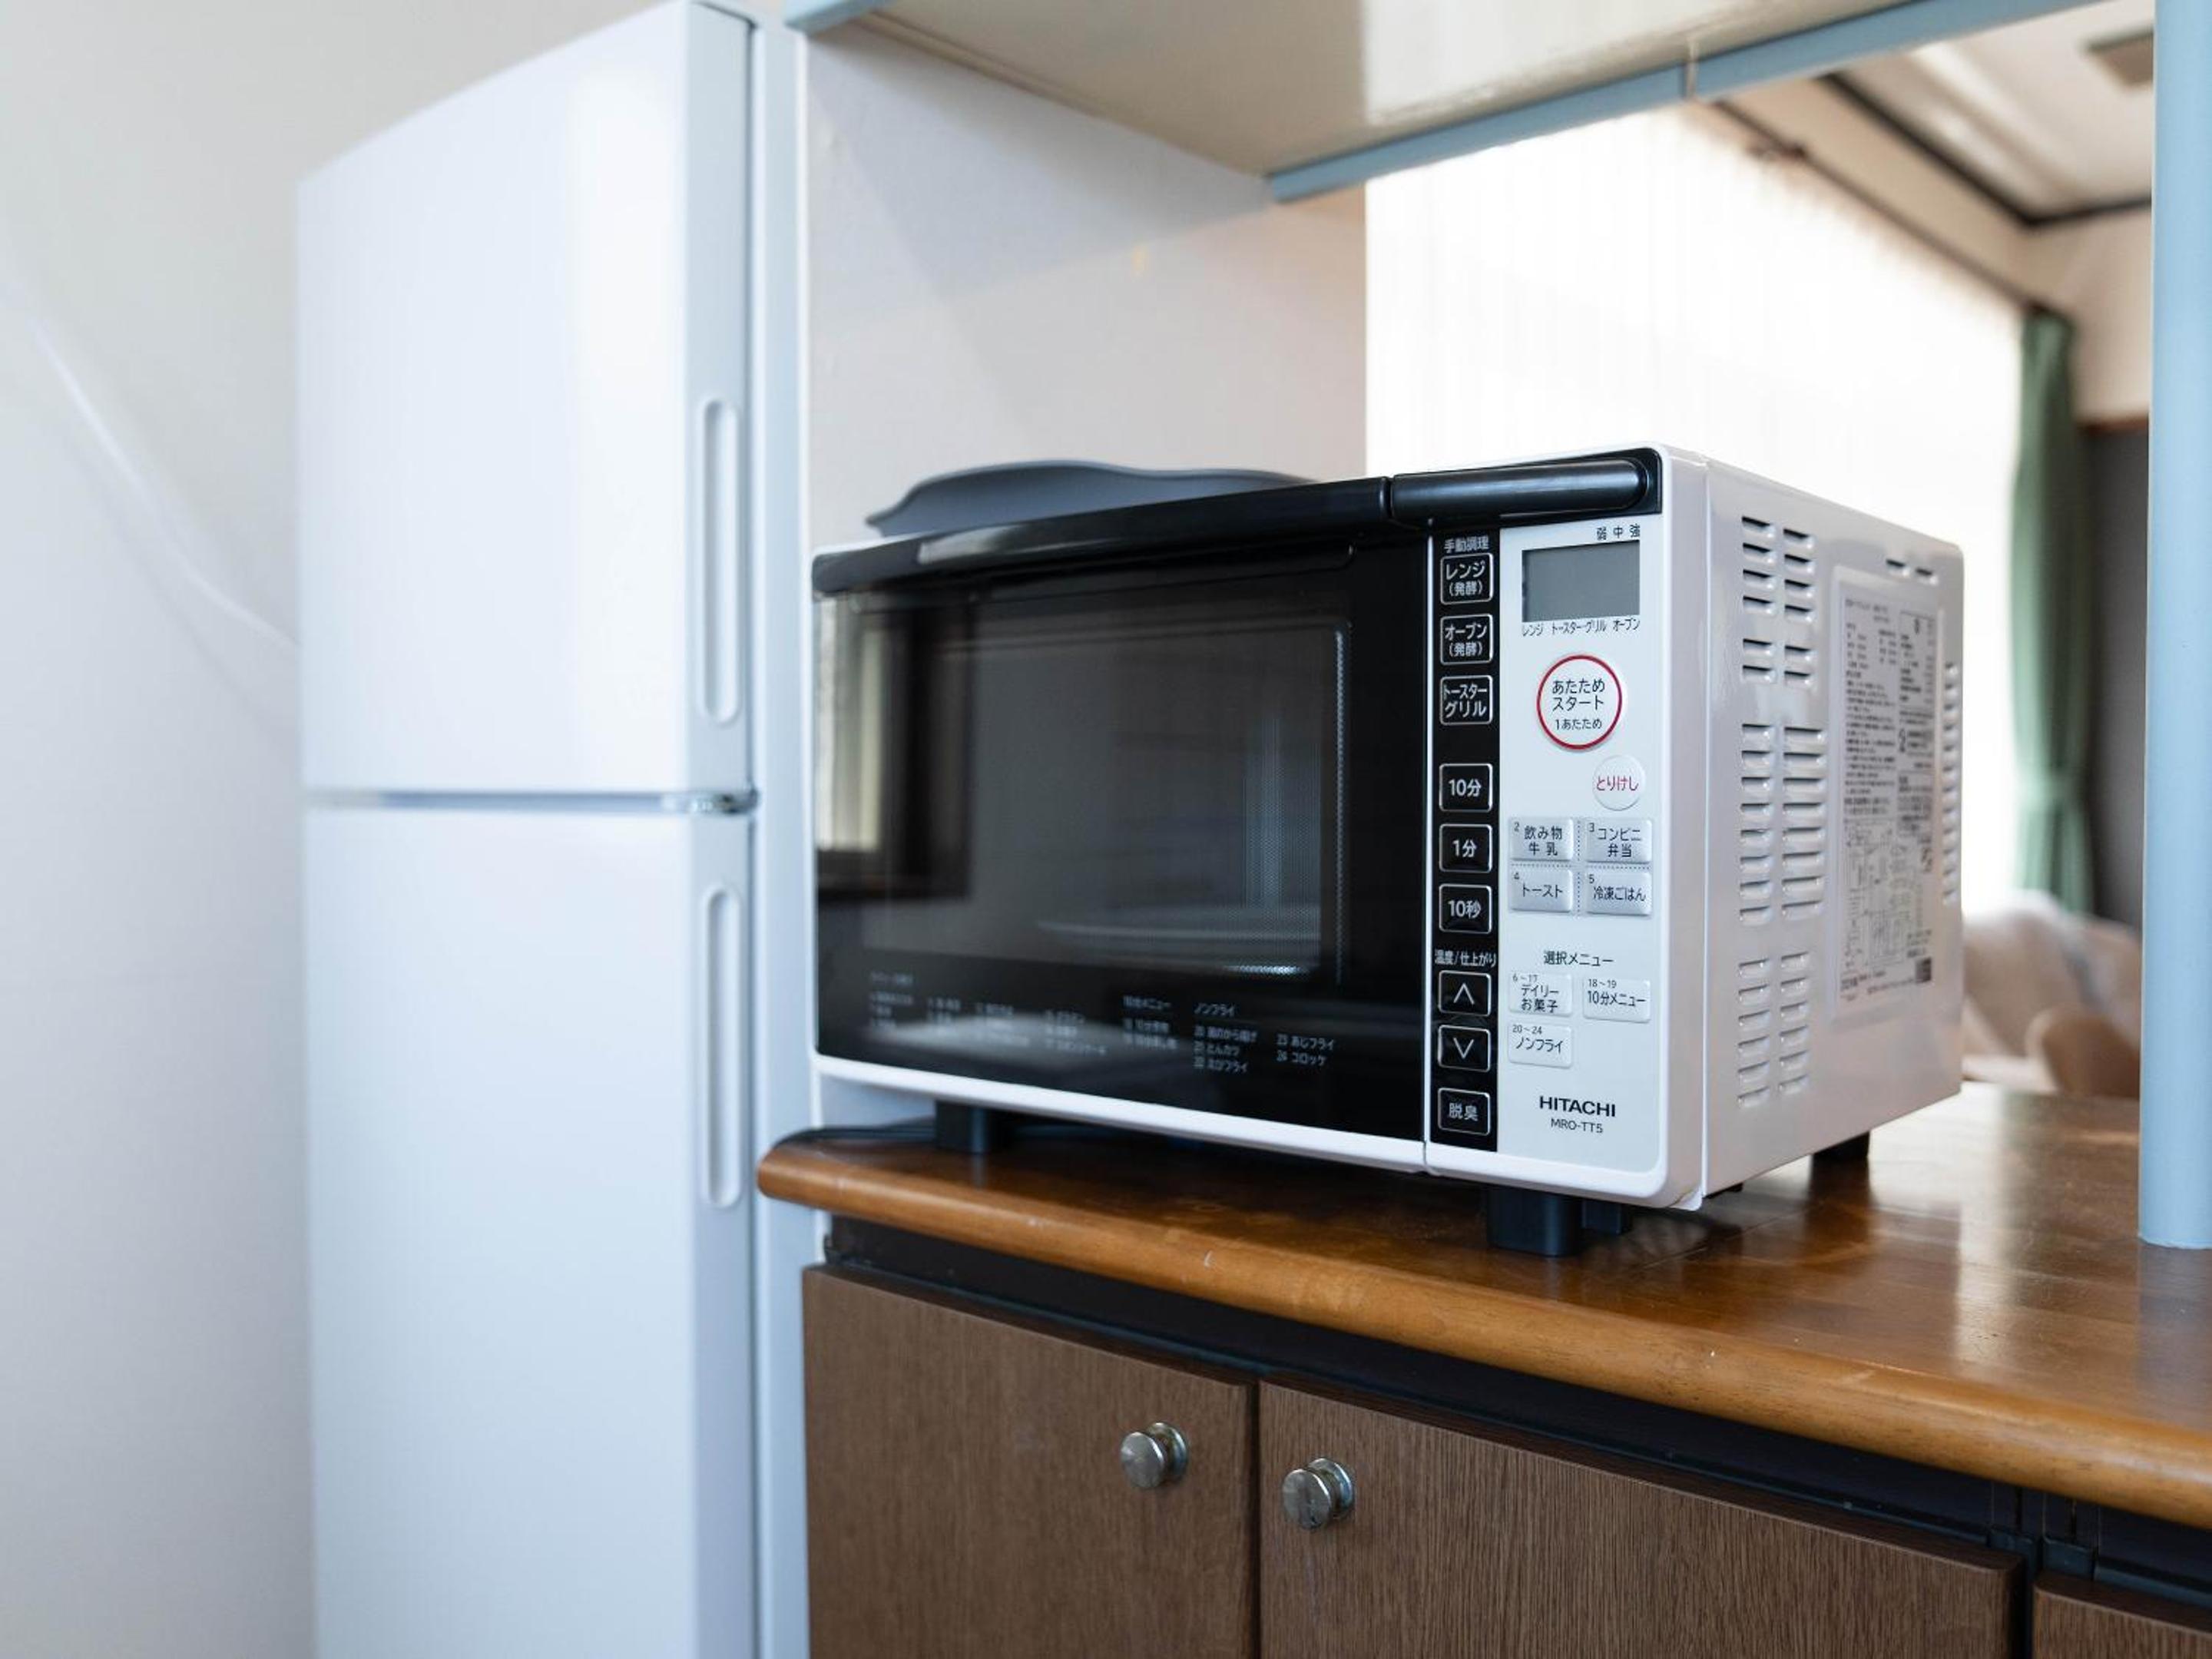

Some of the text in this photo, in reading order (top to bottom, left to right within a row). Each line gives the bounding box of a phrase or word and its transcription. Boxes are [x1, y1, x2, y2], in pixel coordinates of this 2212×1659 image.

[1613, 525, 1623, 538] 中
[1444, 535, 1490, 553] 手動調理
[1446, 560, 1485, 580] レンジ
[1449, 581, 1482, 596] (発酵)
[1445, 622, 1487, 641] オーブン
[1522, 624, 1543, 637] レンジ
[1613, 618, 1640, 631] オーブン
[1449, 640, 1482, 657] (発酵)
[1443, 684, 1487, 700] トースター
[1552, 678, 1604, 696] あたため
[1445, 701, 1487, 717] グリル
[1553, 697, 1604, 711] スタート
[1555, 718, 1602, 730] 1あたため
[1449, 779, 1482, 796] 10分
[1597, 776, 1638, 791] とりけし
[1514, 822, 1562, 840] 2 飲み物
[1589, 823, 1641, 841] 3 コンビニ
[1453, 839, 1476, 857] 1分
[1529, 842, 1558, 856] 牛乳
[1608, 843, 1631, 857] 弁当
[1589, 874, 1594, 883] 5
[1523, 883, 1562, 899] トースト
[1594, 886, 1645, 902] 冷凍ごはん
[1449, 900, 1481, 919] 10秒
[1544, 951, 1613, 966] 選択メニュー
[1522, 984, 1558, 998] デイリー
[1588, 991, 1645, 1007] 10分メニュー
[1522, 998, 1558, 1013] お菓子
[1516, 1037, 1563, 1054] ノンフライ
[1449, 1103, 1478, 1121] 脱臭
[1540, 1096, 1615, 1117] HITACHI
[1551, 1118, 1603, 1133] MRO-TT5
